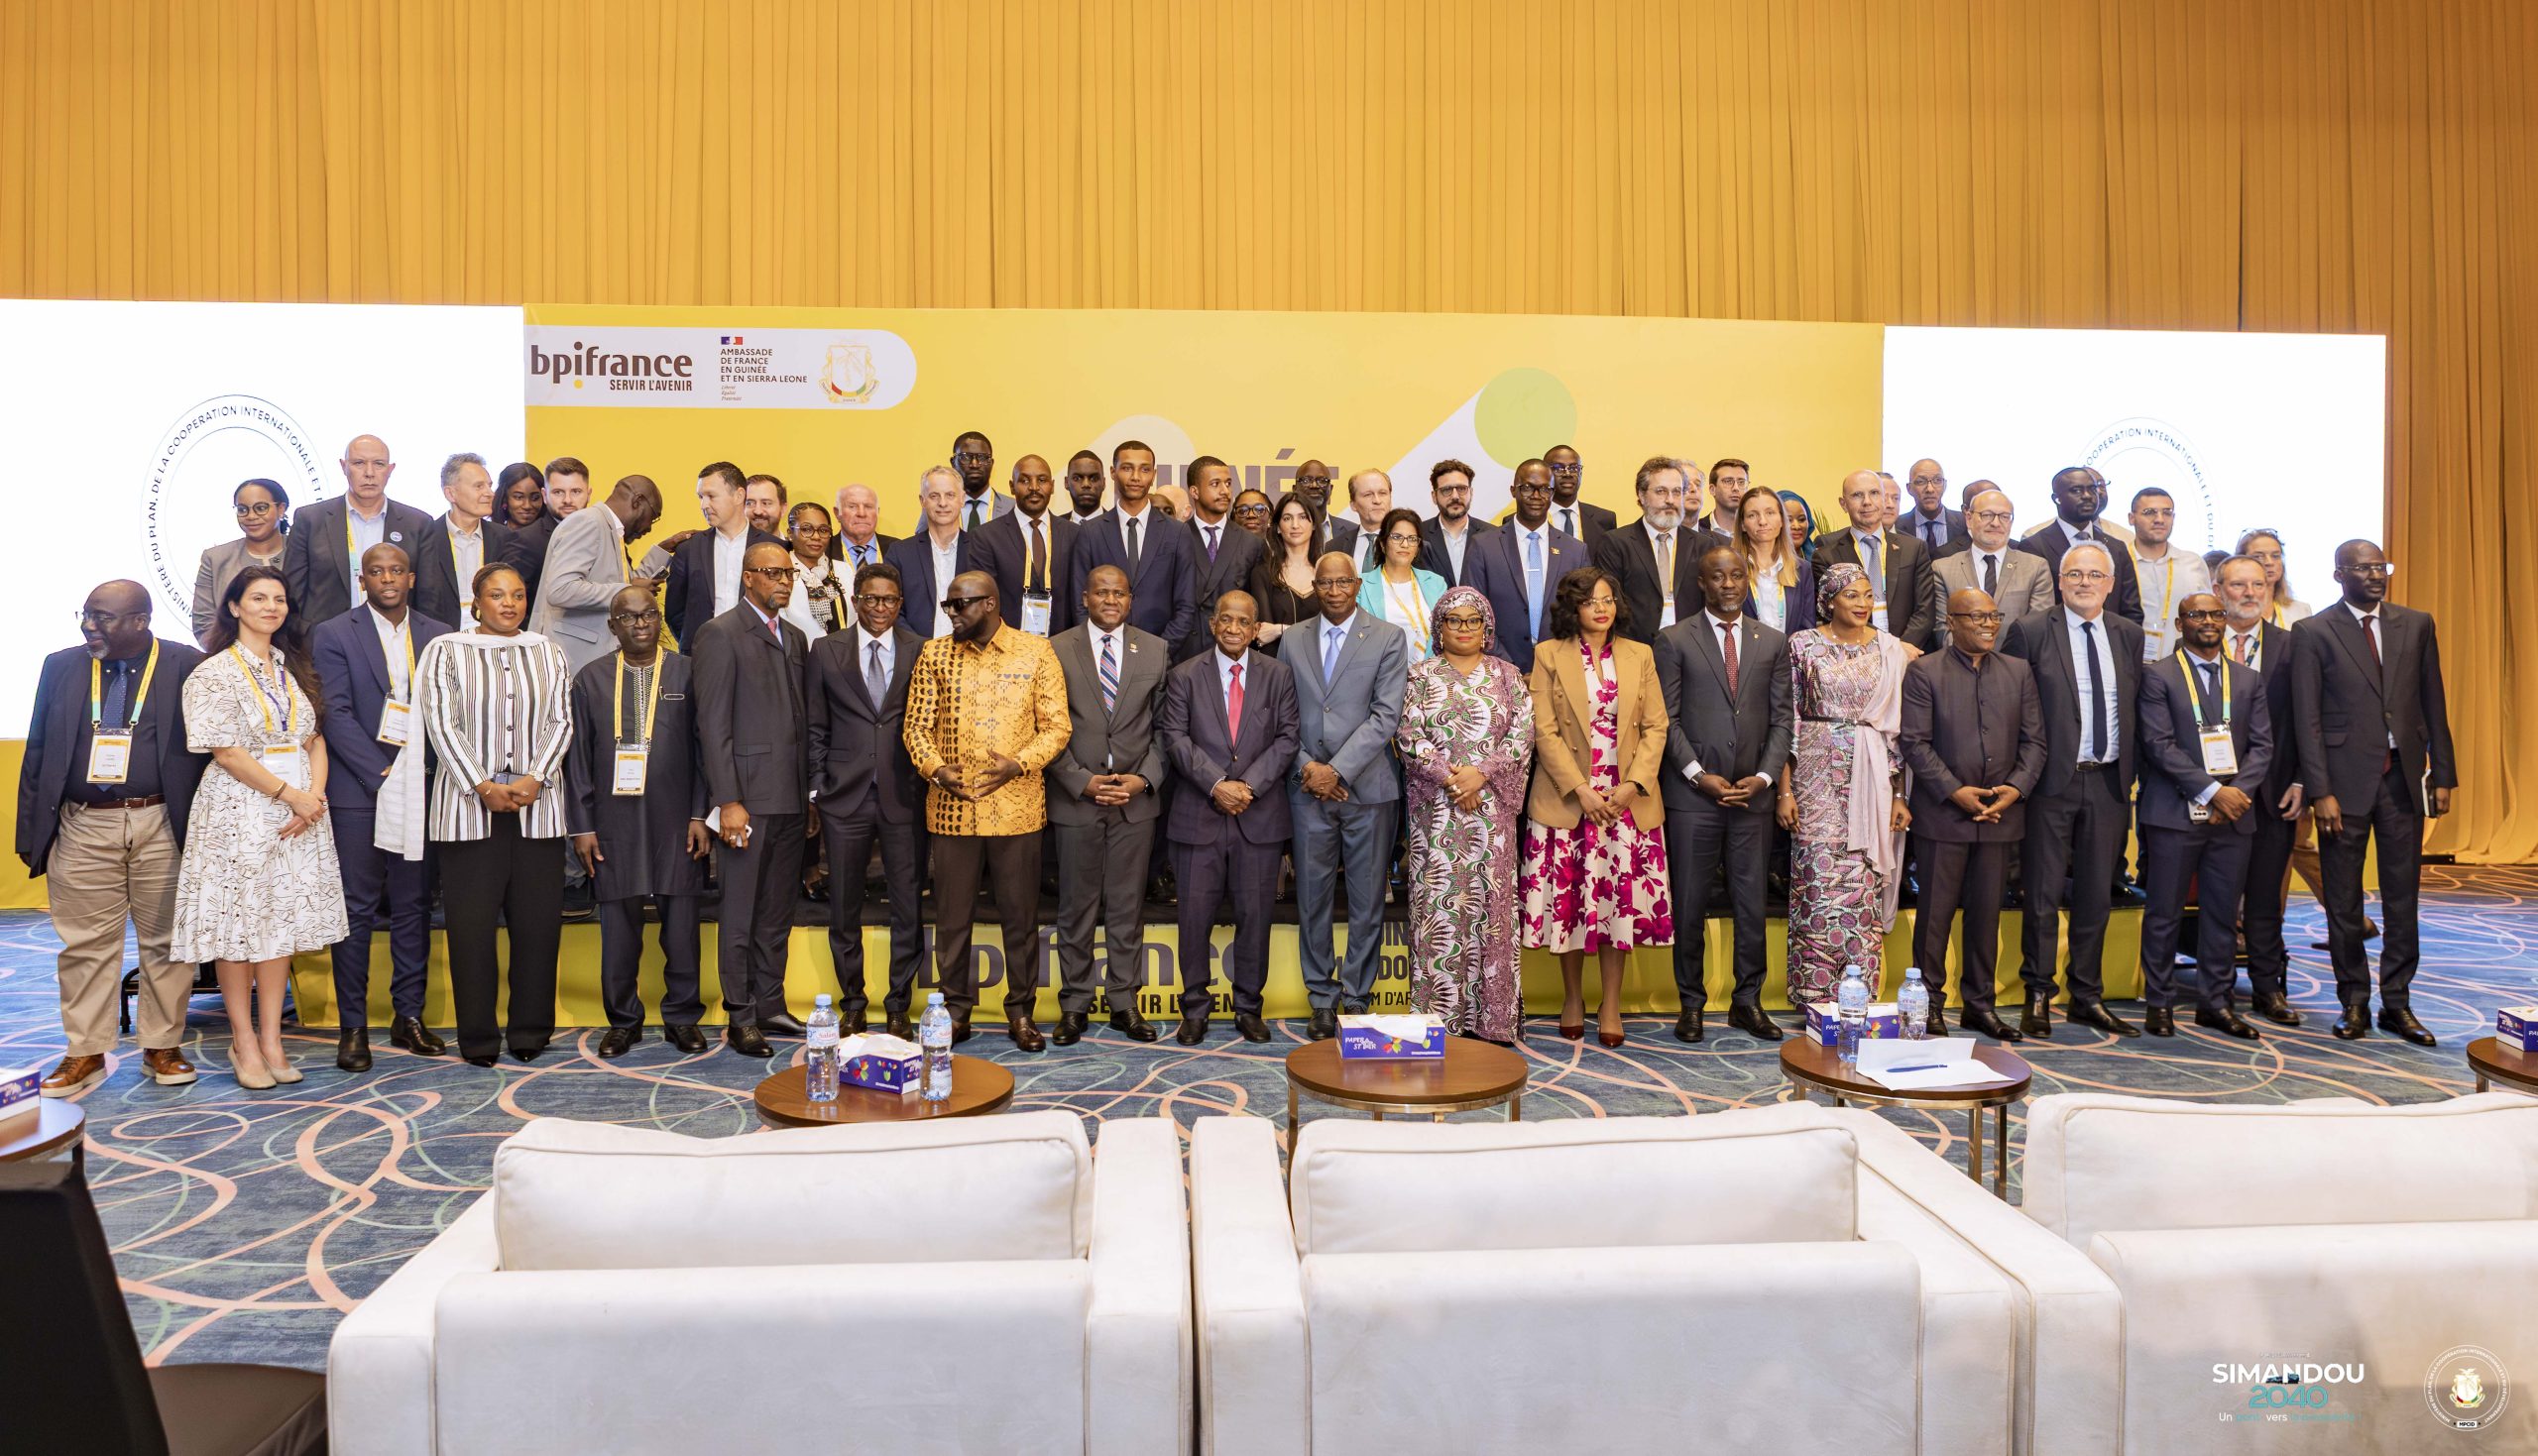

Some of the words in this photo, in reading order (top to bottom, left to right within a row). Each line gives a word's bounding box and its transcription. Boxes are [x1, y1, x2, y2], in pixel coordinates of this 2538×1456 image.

[531, 341, 692, 384] bpifrance
[735, 365, 766, 374] GUINÉE
[610, 380, 645, 391] SERVIR
[168, 405, 237, 455] COOPERATION
[240, 406, 315, 475] INTERNATIONALE
[158, 458, 170, 473] LA
[152, 477, 162, 493] DE
[311, 477, 321, 492] ET
[151, 543, 162, 561] DU
